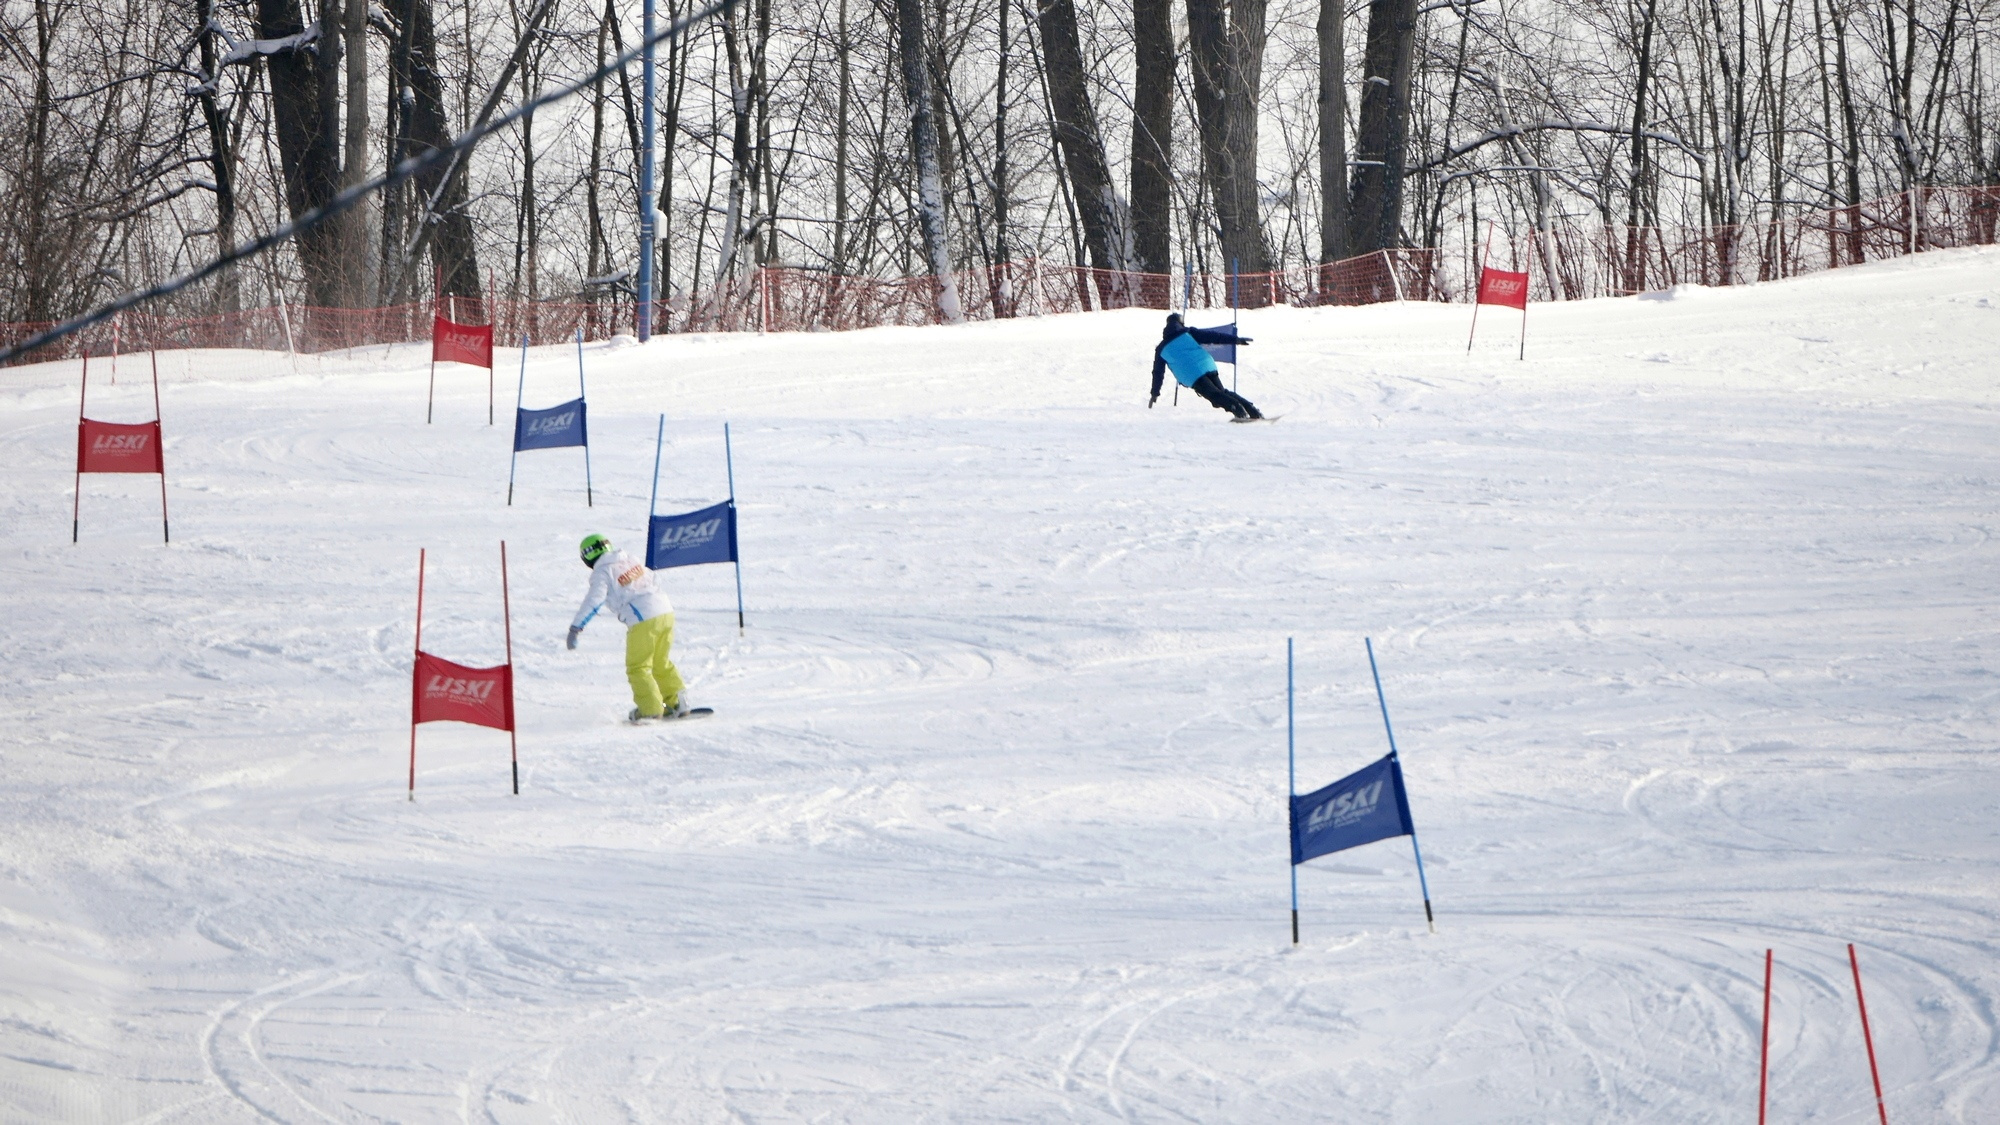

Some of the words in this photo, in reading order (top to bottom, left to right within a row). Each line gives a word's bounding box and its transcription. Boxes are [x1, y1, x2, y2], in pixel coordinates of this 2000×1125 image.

[1489, 278, 1522, 292] LISKI
[444, 331, 486, 349] LISKI
[528, 411, 576, 432] LISKI
[92, 434, 149, 449] LISKI
[660, 518, 721, 544] LISKI
[426, 675, 495, 699] LISKI
[1308, 780, 1383, 826] LISKI
